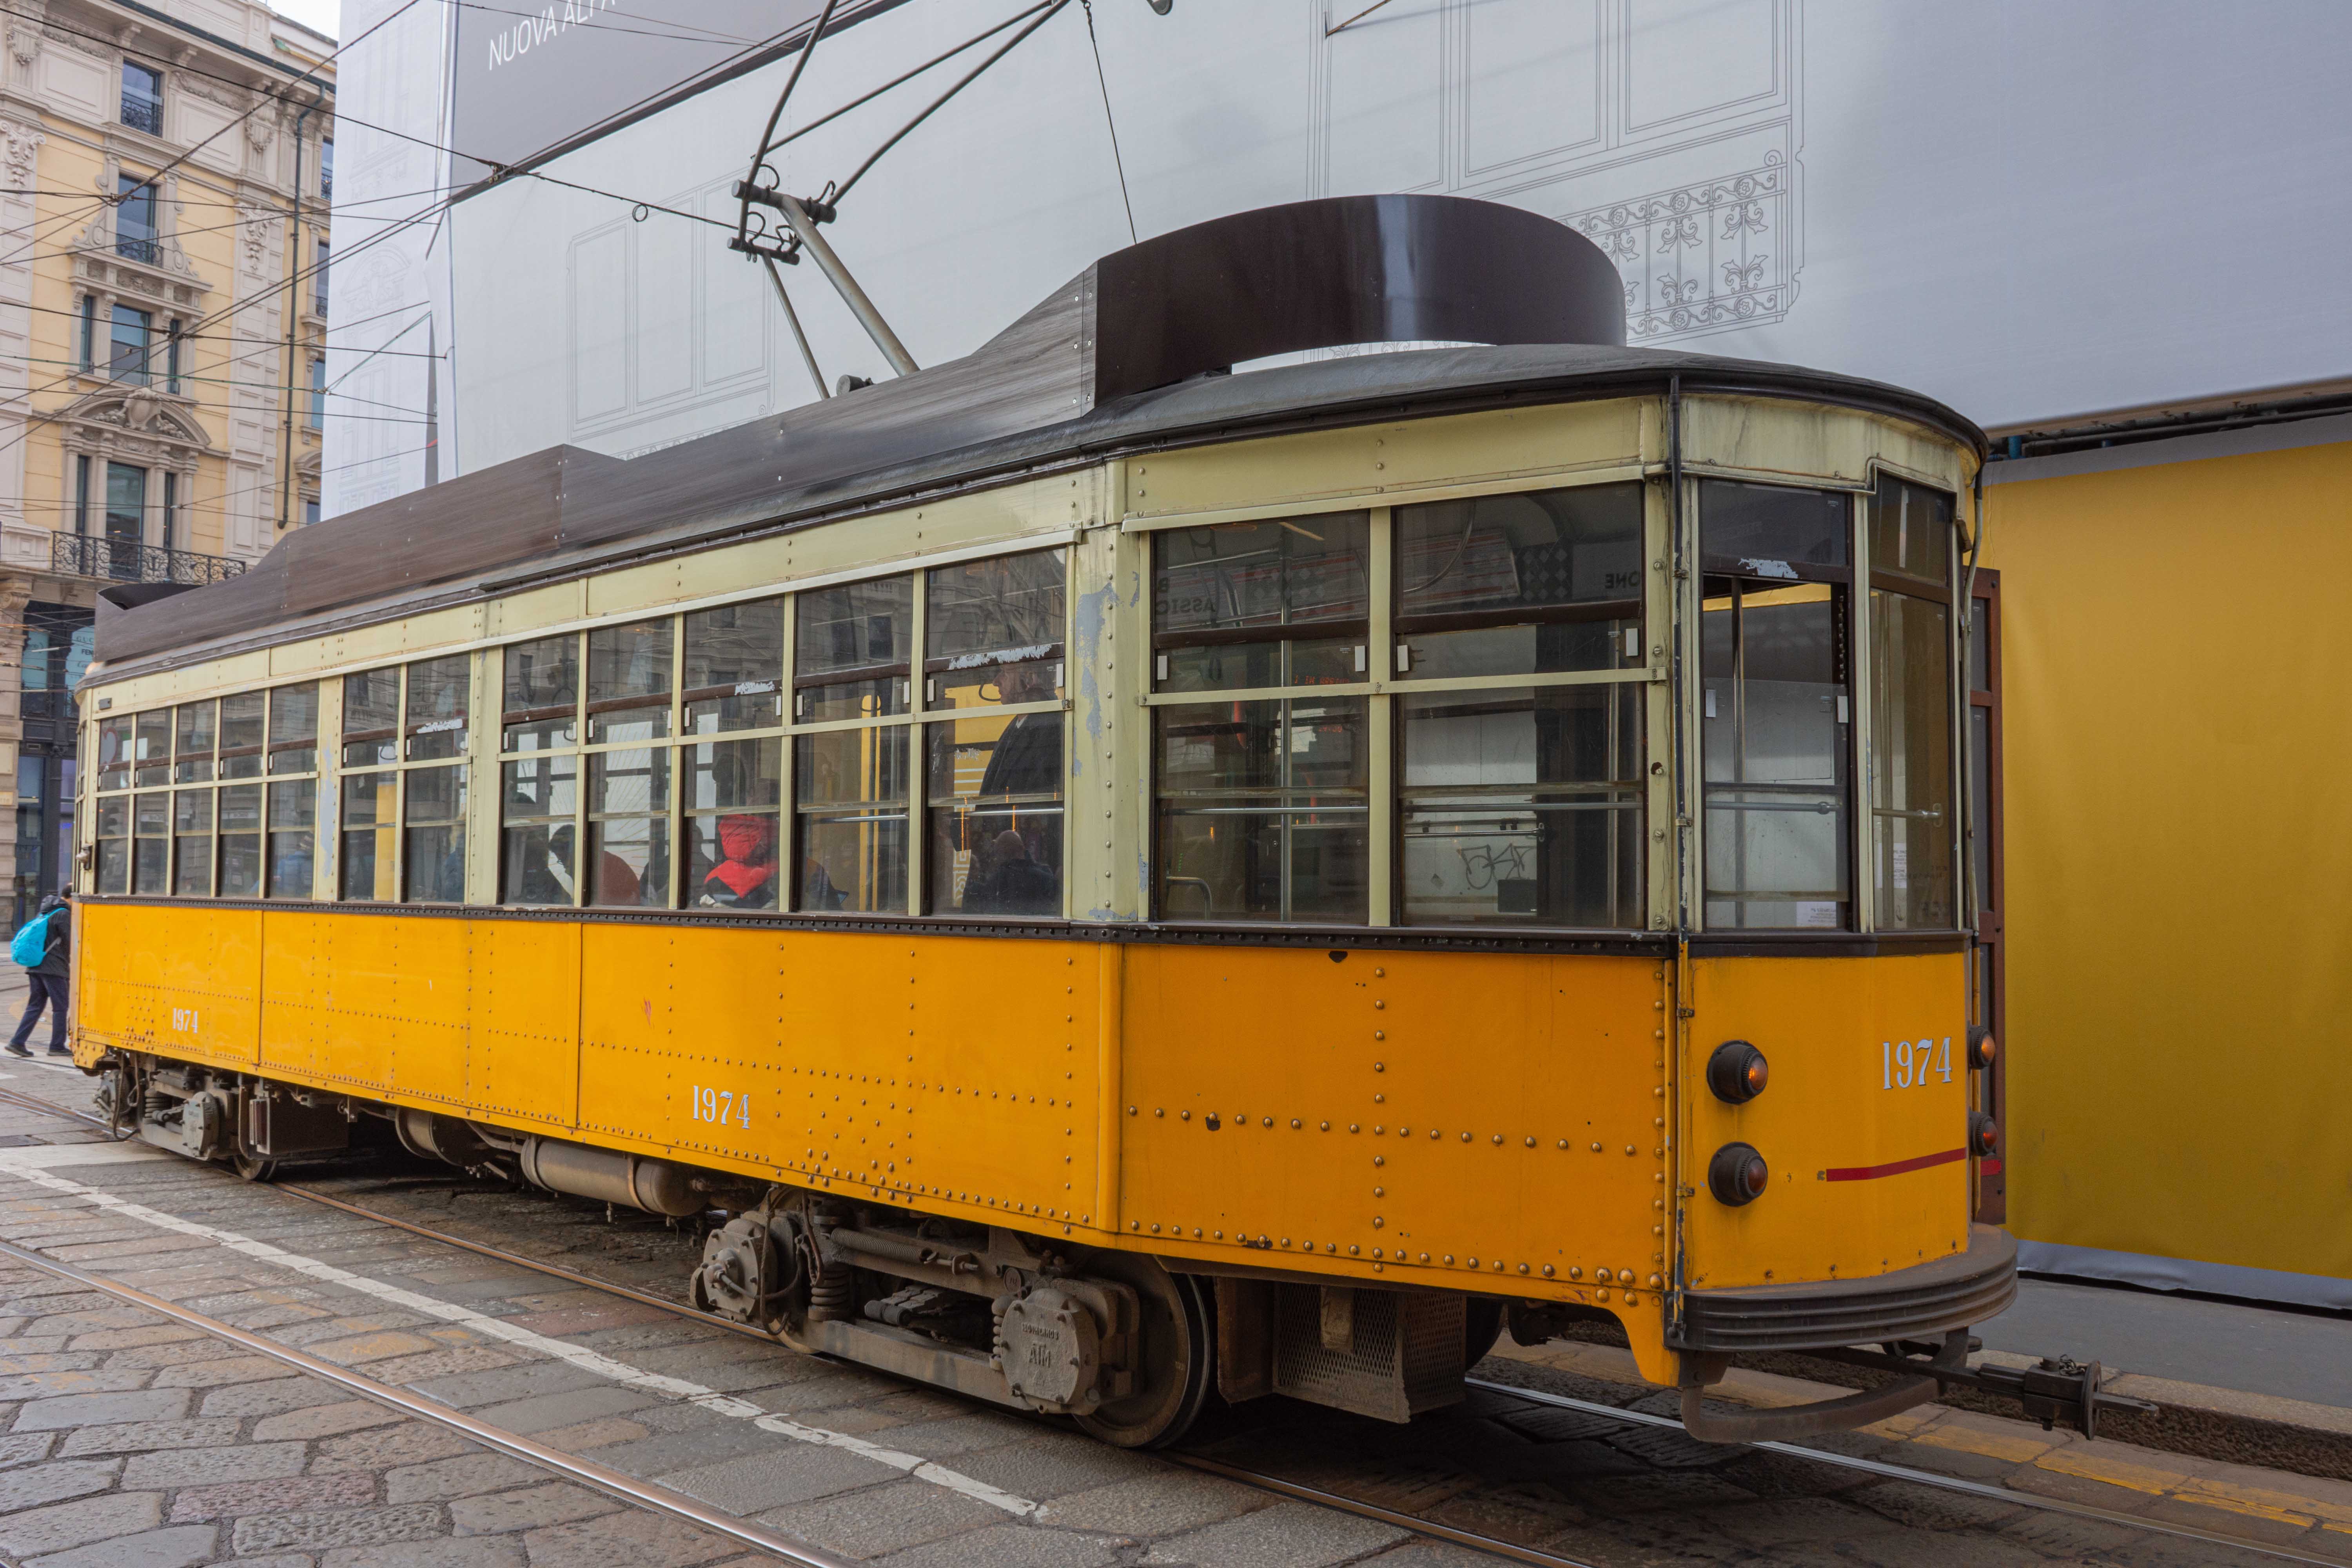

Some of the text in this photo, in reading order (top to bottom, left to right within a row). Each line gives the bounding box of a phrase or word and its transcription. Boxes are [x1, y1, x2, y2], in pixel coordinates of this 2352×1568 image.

[489, 0, 615, 71] NUOVA AL
[172, 1007, 198, 1034] 1974
[1883, 1036, 1953, 1090] 1974
[693, 1085, 750, 1129] 1974
[1029, 1341, 1051, 1368] ATM
